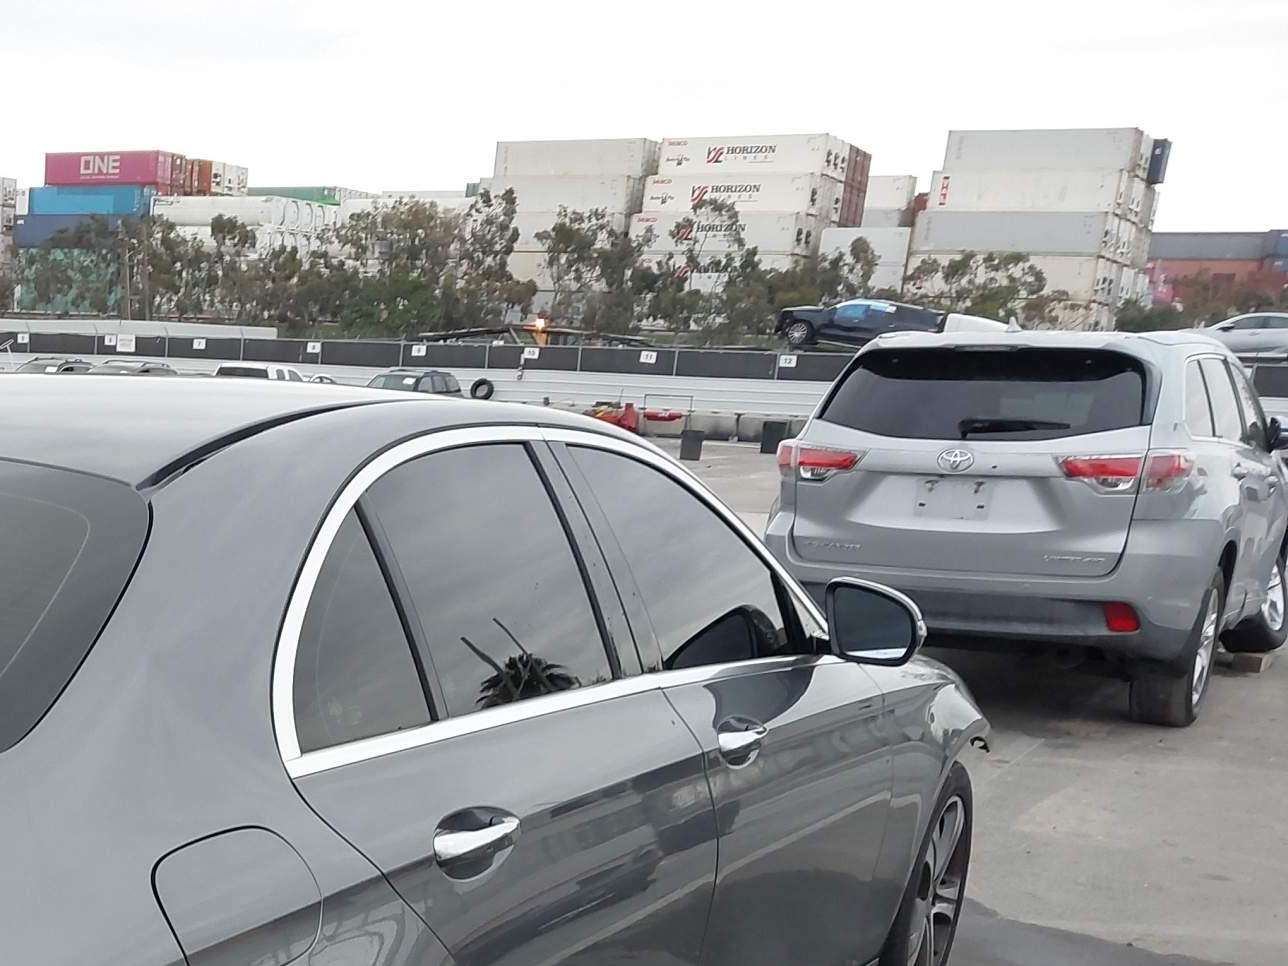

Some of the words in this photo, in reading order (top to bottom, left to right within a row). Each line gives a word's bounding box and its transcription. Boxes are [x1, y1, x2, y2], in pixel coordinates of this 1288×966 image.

[725, 145, 776, 154] HORIZON
[80, 155, 120, 175] ONE
[711, 184, 761, 194] HORIZON
